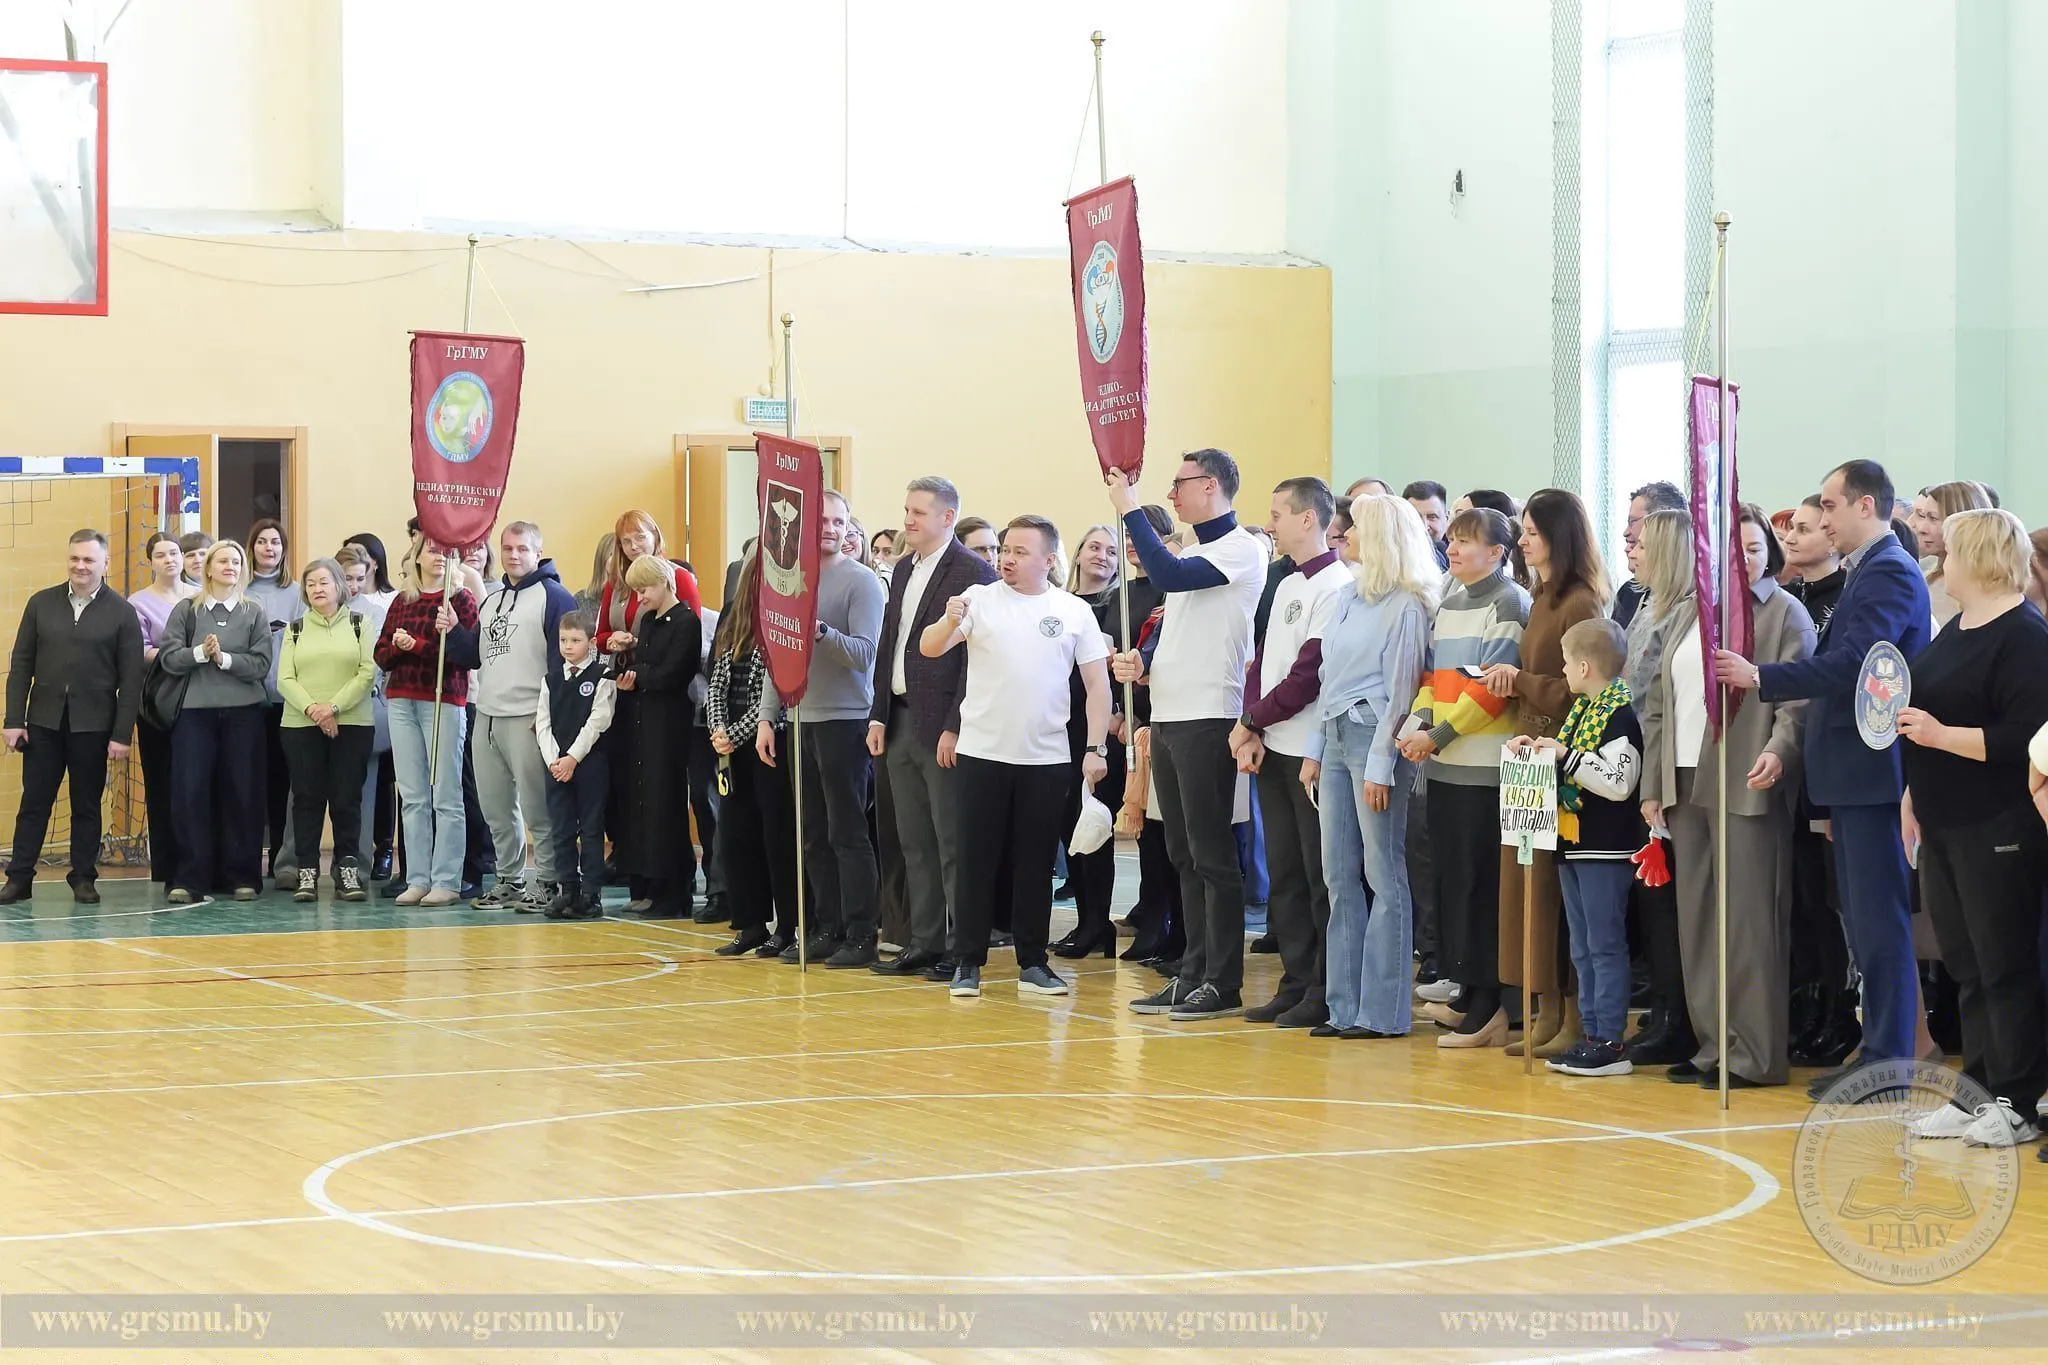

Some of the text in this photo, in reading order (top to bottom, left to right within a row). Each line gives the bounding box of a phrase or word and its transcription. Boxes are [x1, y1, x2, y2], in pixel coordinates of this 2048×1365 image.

[446, 345, 488, 360] ГрГМУ
[416, 481, 502, 498] ПЕДИАТРИЧЕСКИЙ
[427, 493, 486, 508] ФАКУЛЬТЕТ
[1505, 786, 1545, 809] КУБОК
